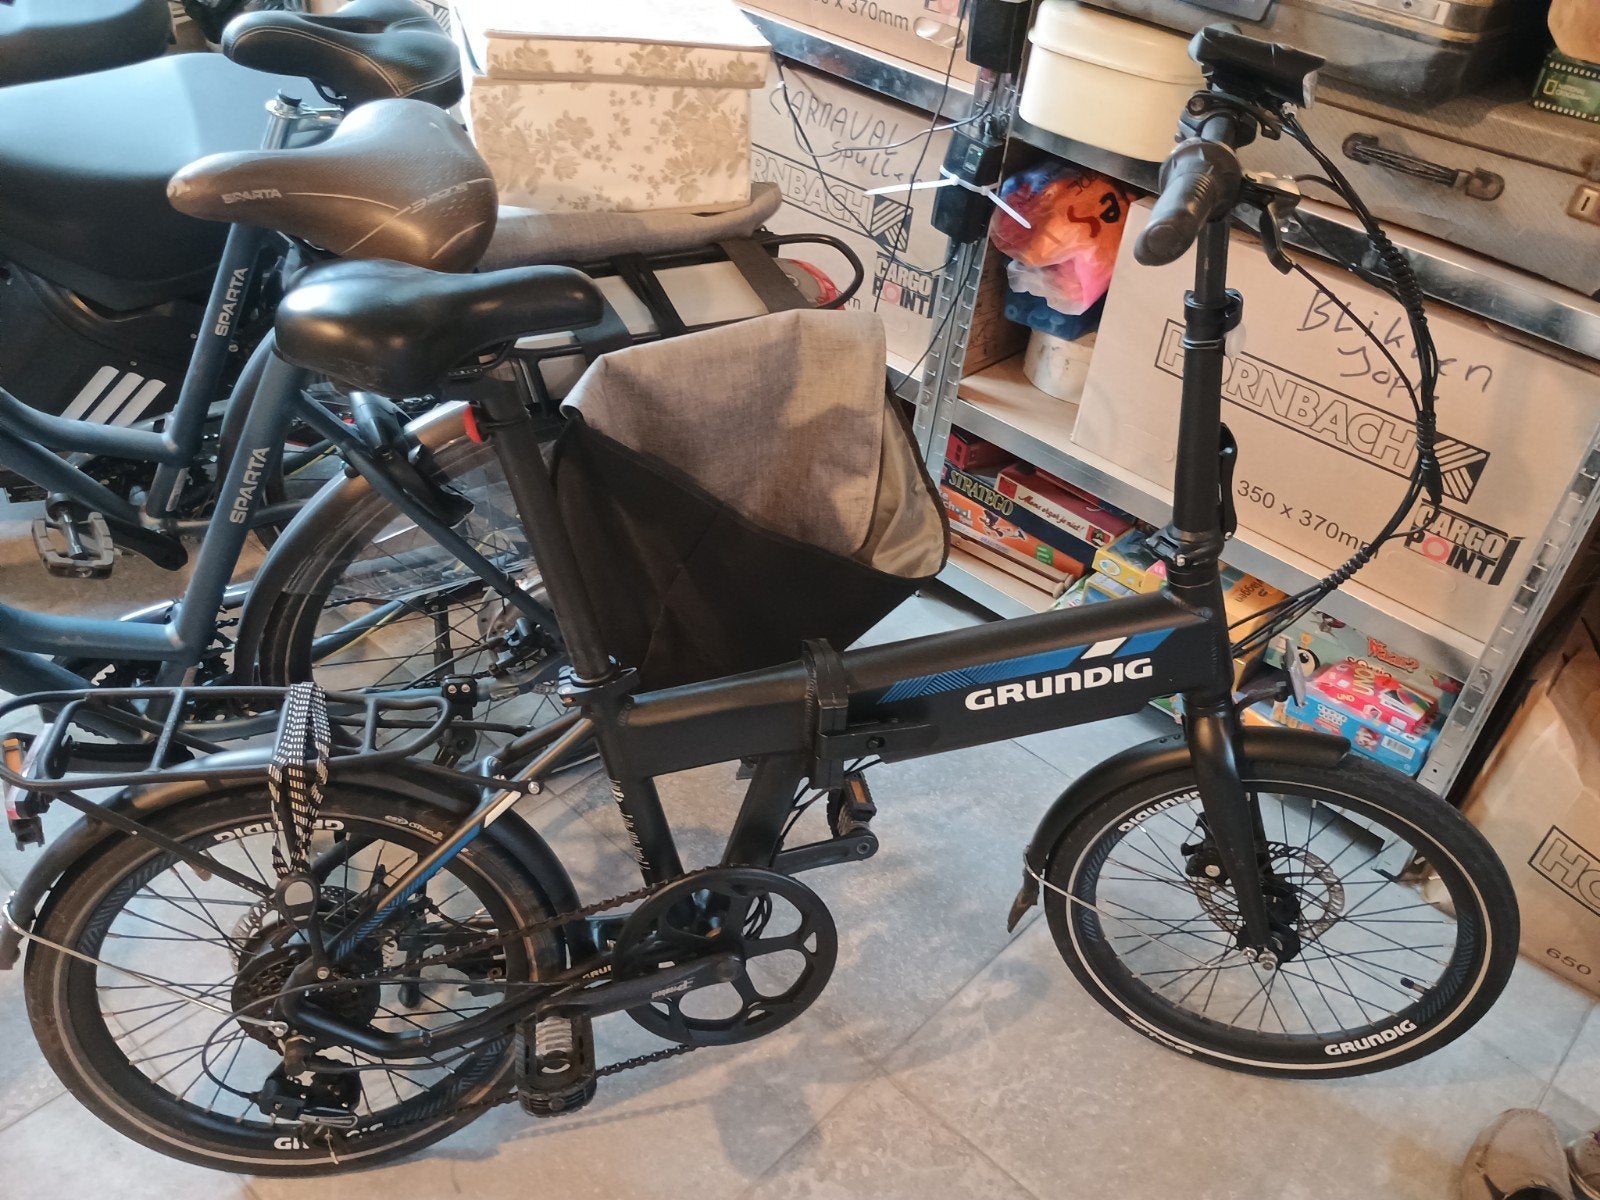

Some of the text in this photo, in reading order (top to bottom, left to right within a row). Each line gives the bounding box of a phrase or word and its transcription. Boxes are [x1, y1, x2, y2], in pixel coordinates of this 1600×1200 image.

[221, 187, 282, 203] SPARTA
[751, 151, 870, 229] RNBACH
[873, 276, 930, 317] POINT
[875, 256, 933, 297] CARGO
[214, 267, 248, 337] SPARTA
[1163, 328, 1419, 469] HRNBACH
[229, 446, 271, 525] SPARTA
[948, 469, 1014, 516] STRATEGO
[1237, 480, 1275, 509] 350
[1280, 503, 1291, 519] x
[1402, 525, 1496, 582] POINT
[1414, 503, 1507, 560] CARGO
[964, 657, 1153, 711] GRUNDIG
[1336, 692, 1356, 702] UNO
[213, 818, 345, 842] GRNDIG
[1546, 946, 1592, 976] 650
[1324, 1019, 1417, 1057] GRUNDIG
